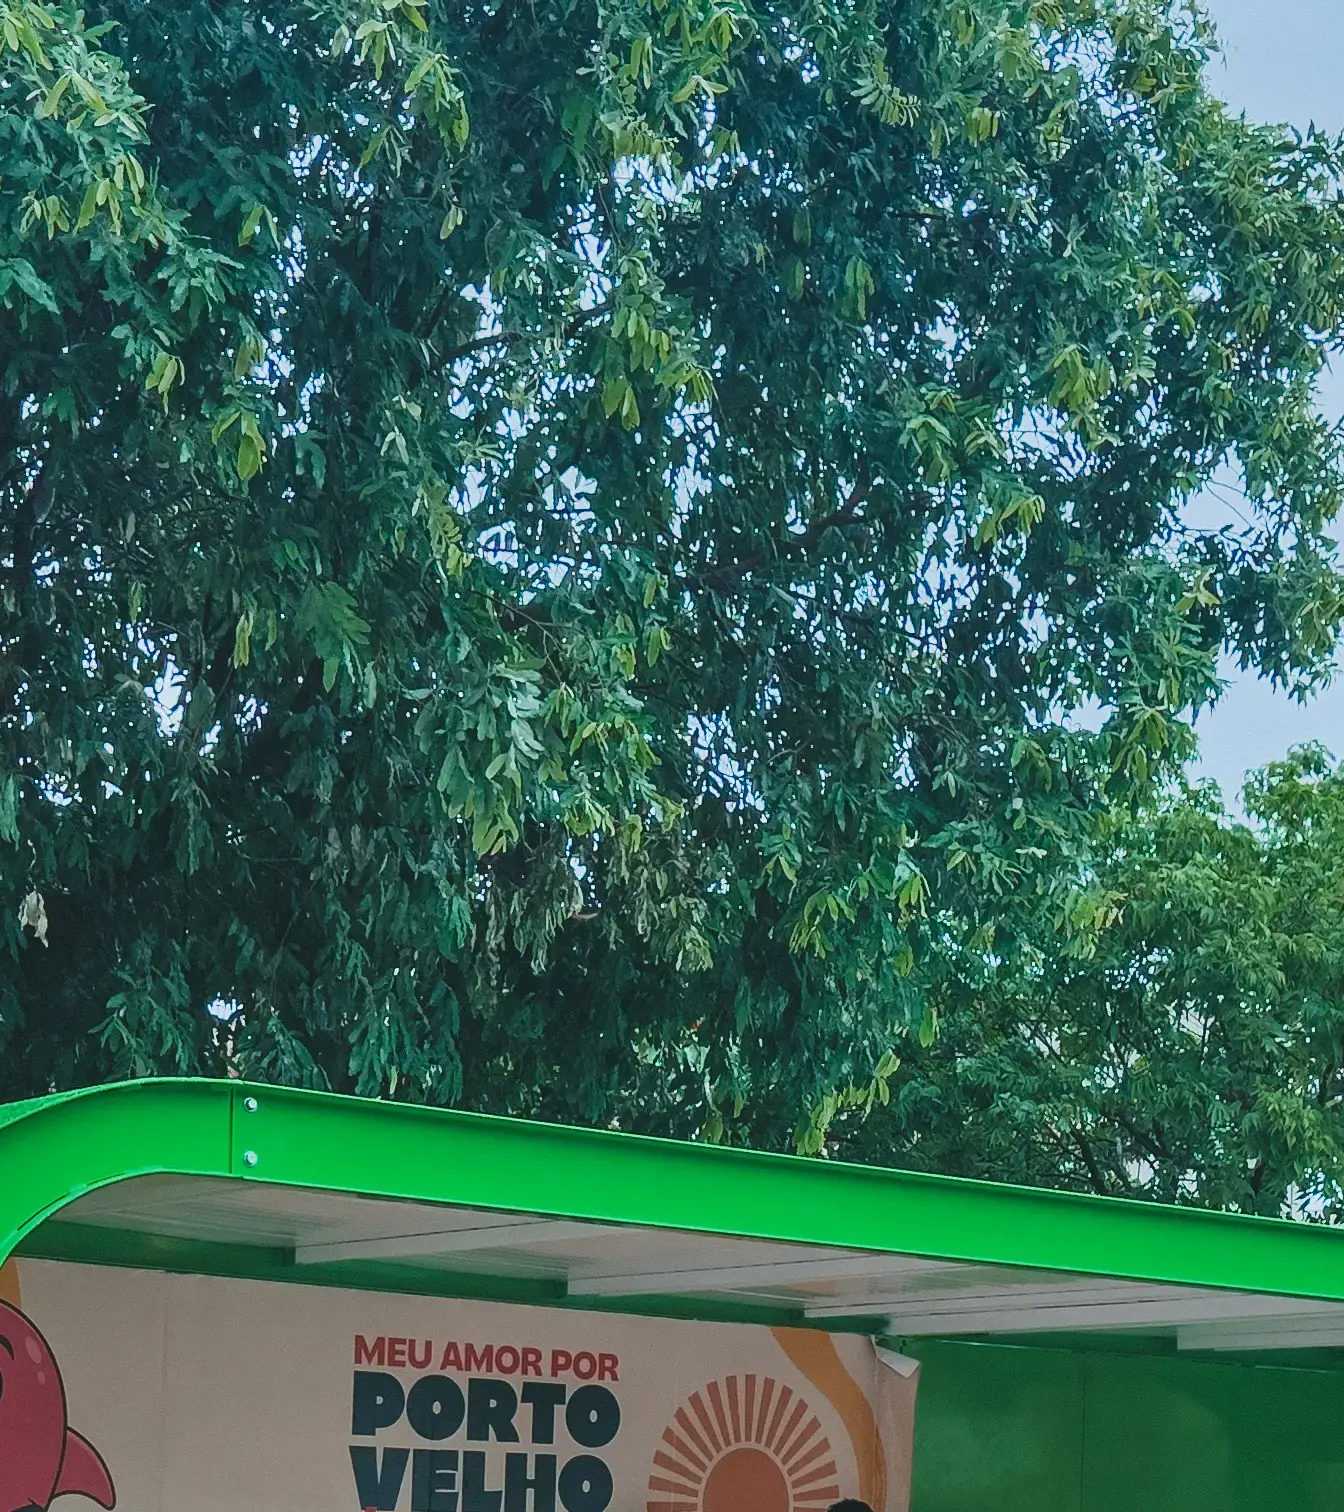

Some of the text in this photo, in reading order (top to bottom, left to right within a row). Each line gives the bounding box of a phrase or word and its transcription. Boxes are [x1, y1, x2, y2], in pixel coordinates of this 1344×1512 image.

[354, 1335, 619, 1381] MEU AMOR POR
[352, 1370, 621, 1448] PORTO
